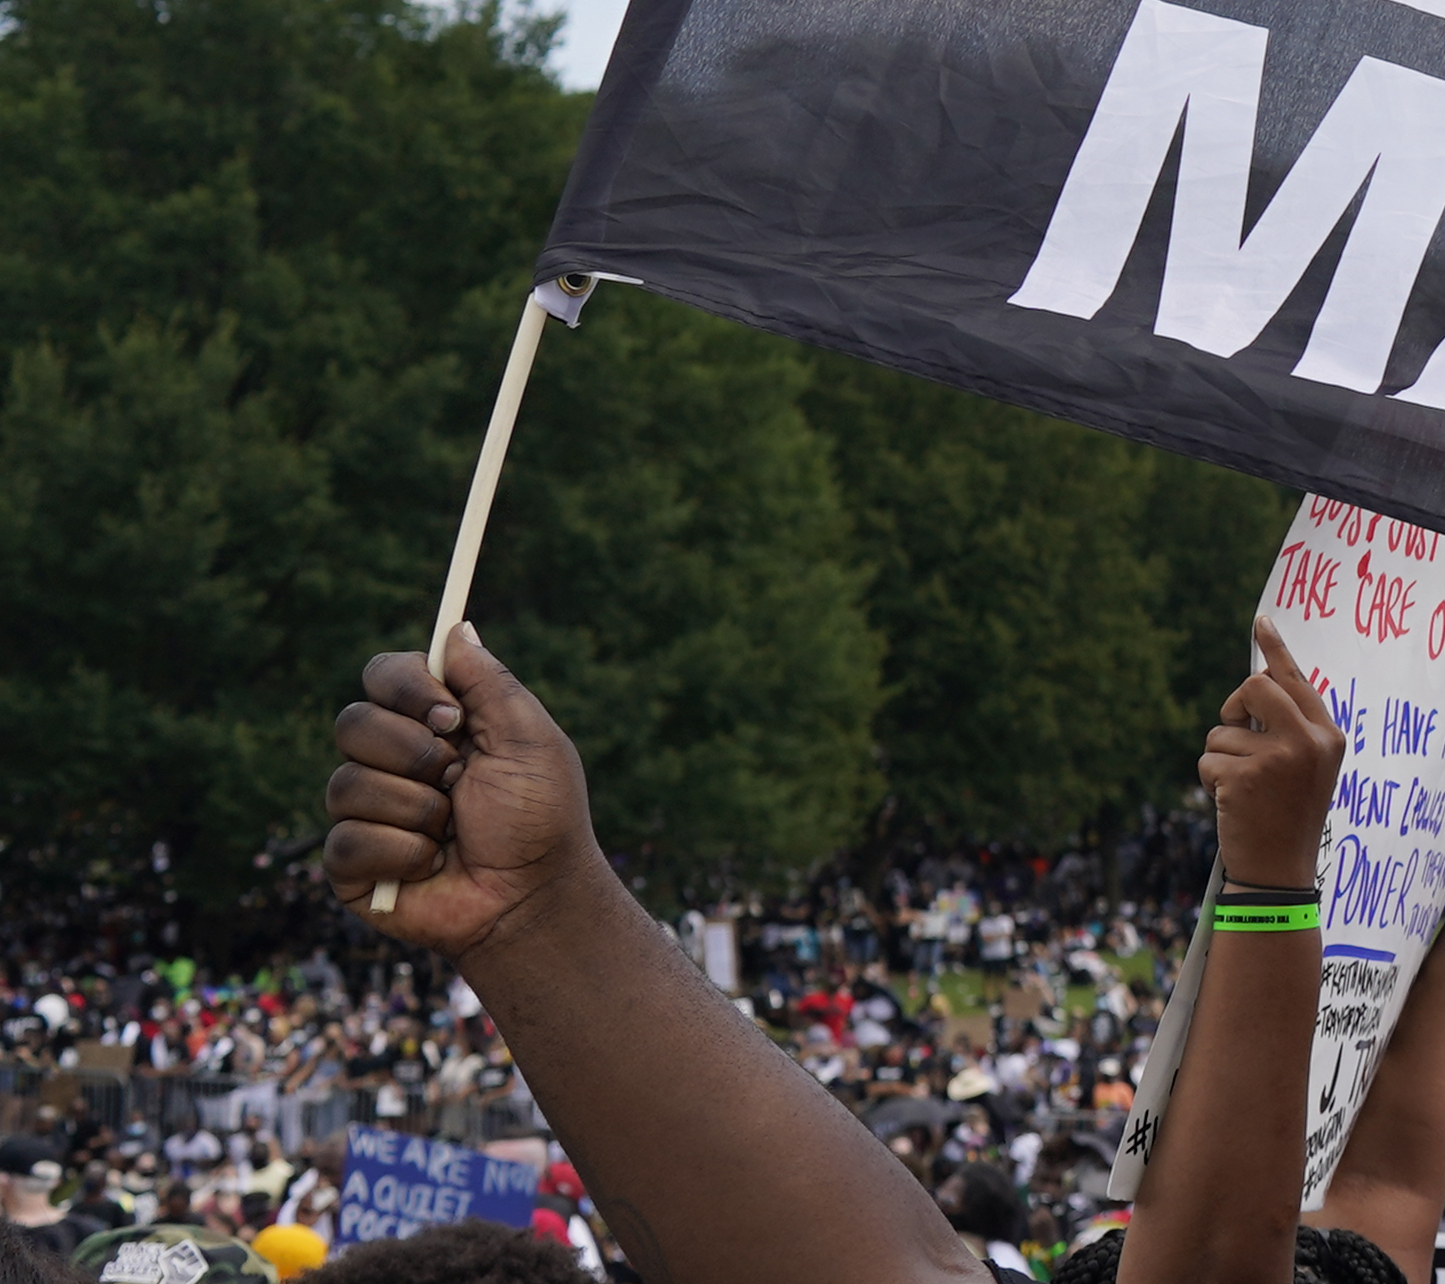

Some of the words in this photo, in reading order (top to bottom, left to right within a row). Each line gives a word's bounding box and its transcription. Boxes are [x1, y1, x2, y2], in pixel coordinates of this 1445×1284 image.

[1275, 540, 1342, 621] TAKE
[1354, 571, 1418, 644] CARE
[1381, 696, 1438, 757] HAVE
[348, 1121, 400, 1165] WE
[402, 1137, 472, 1186] ARE
[342, 1169, 368, 1204] A
